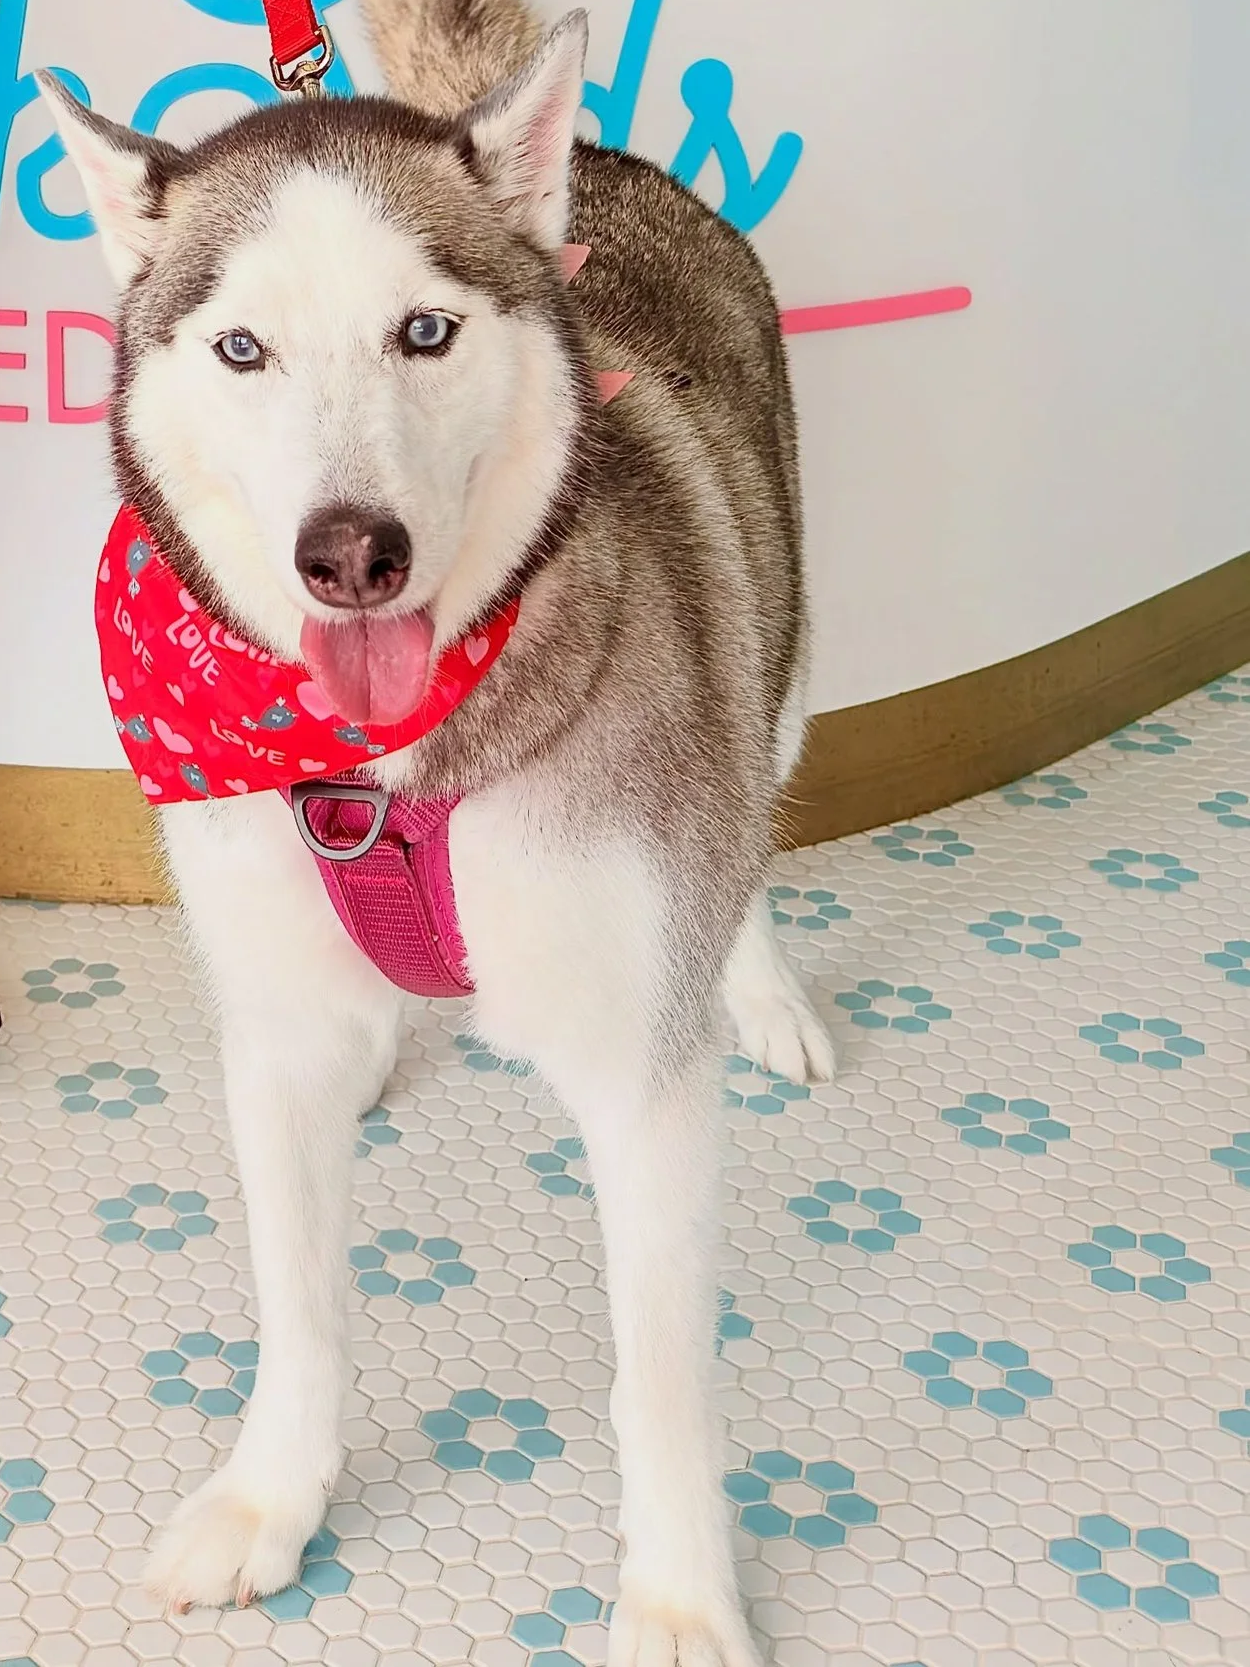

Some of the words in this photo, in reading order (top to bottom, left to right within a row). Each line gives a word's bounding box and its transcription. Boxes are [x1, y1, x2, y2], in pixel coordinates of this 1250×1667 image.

[113, 596, 154, 675] LOVE
[166, 612, 223, 687] LOVE
[209, 719, 287, 766] LOVE
